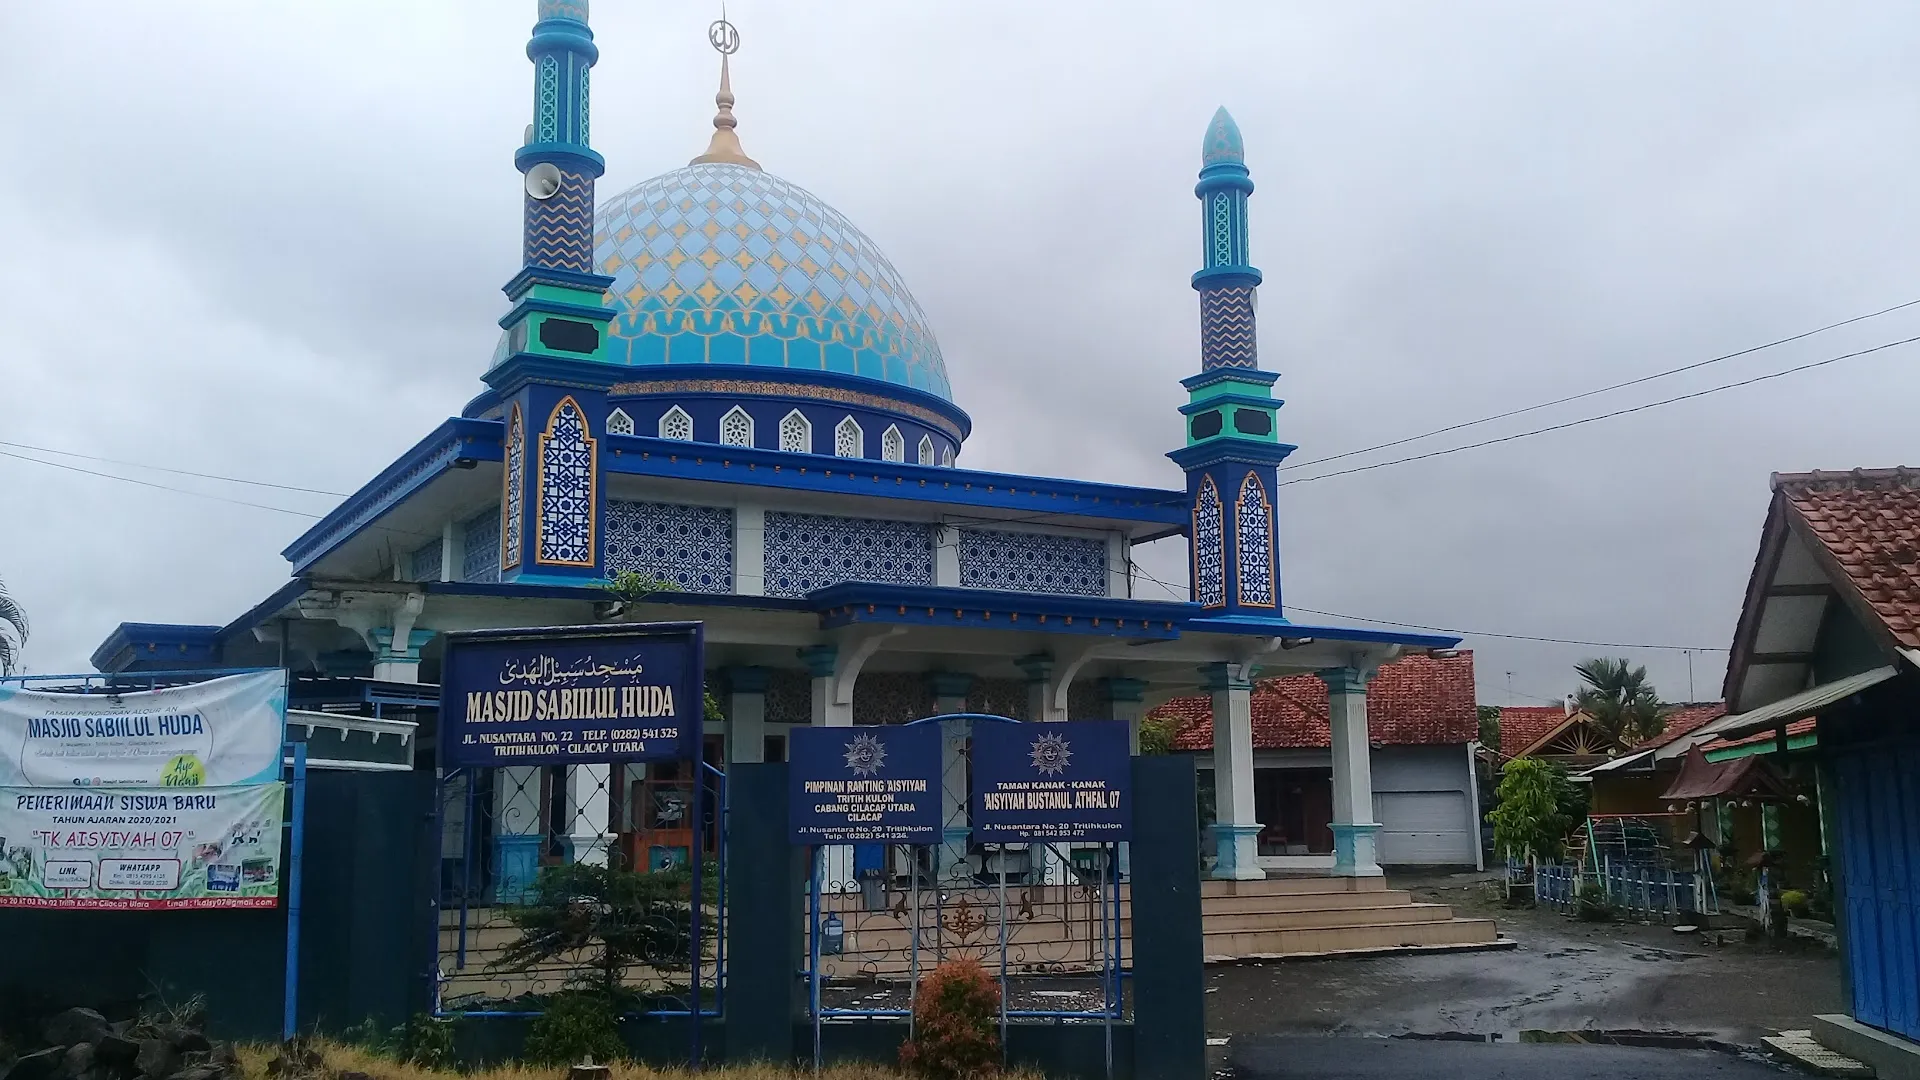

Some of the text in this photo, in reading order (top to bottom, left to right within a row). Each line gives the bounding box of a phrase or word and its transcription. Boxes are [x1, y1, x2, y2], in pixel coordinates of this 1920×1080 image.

[465, 685, 675, 723] MASJID SABIILUL HUDA
[28, 714, 203, 738] MASJID SABIILUL HUDA
[462, 735, 477, 745] JL.
[479, 732, 536, 744] NUSANTARA
[541, 732, 558, 742] NO.
[560, 731, 573, 742] 22
[582, 730, 607, 741] TELP.
[611, 729, 640, 740] (0282)
[494, 745, 526, 756] TRITIH
[527, 744, 560, 755] KULON
[568, 743, 609, 754] CILACAP
[612, 742, 645, 753] UTARA
[174, 757, 194, 777] Ayo
[805, 781, 844, 793] PIMPINAN
[847, 780, 884, 793] RANTING
[997, 782, 1029, 790] TAMAN
[1032, 781, 1065, 789] KANAK
[1072, 780, 1106, 788] KANAK
[17, 795, 216, 811] PENERIMAAN SISWA BARU
[837, 794, 894, 803] TRITIH KULON
[1027, 791, 1072, 810] BUSTANUL
[1075, 791, 1107, 809] ATHFAL
[1110, 790, 1120, 808] 07
[815, 803, 915, 813] CABANG CILACAP UTARA
[52, 816, 176, 825] TAHUN AJARAN 2020/2021
[847, 813, 882, 822] CILACAP
[65, 830, 156, 847] AISYIYAH
[847, 832, 873, 840] (0282)
[59, 867, 77, 875] LINK
[119, 863, 161, 872] WHATSAPP
[99, 900, 128, 908] Cilacap
